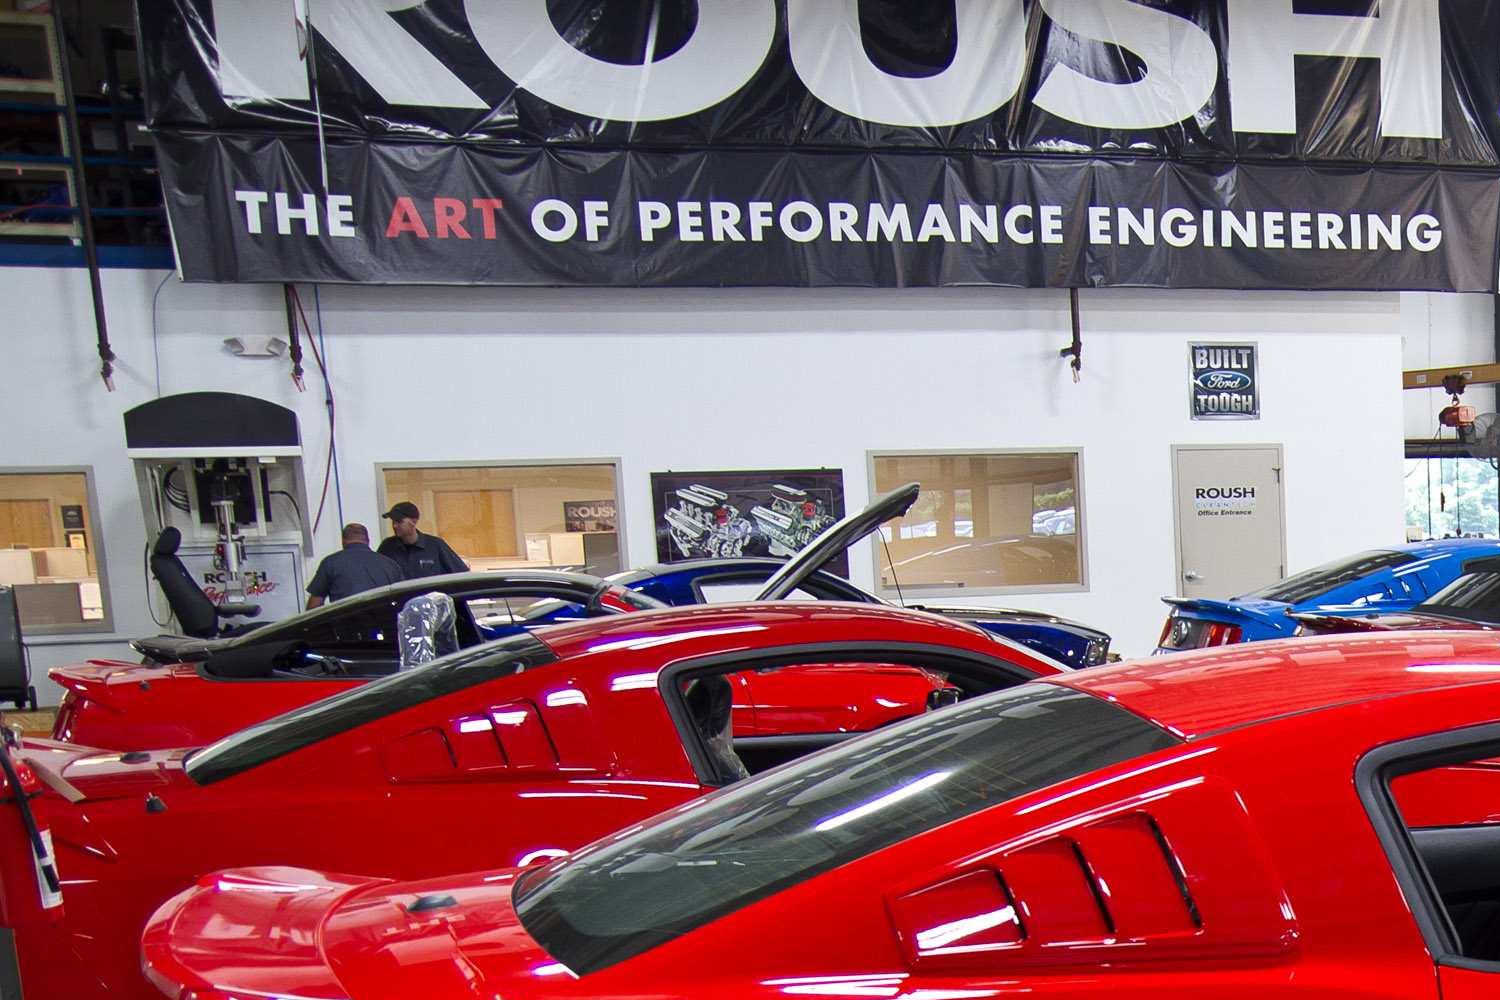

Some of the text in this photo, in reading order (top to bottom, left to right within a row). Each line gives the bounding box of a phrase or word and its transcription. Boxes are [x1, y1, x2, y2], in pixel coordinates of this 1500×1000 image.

[235, 191, 1442, 252] THE ART OF PERFORMANCE ENGINEERING
[1195, 348, 1251, 369] BUILT
[1207, 373, 1241, 389] Ford
[1197, 392, 1253, 412] TOUGH
[1195, 487, 1255, 499] ROUSH
